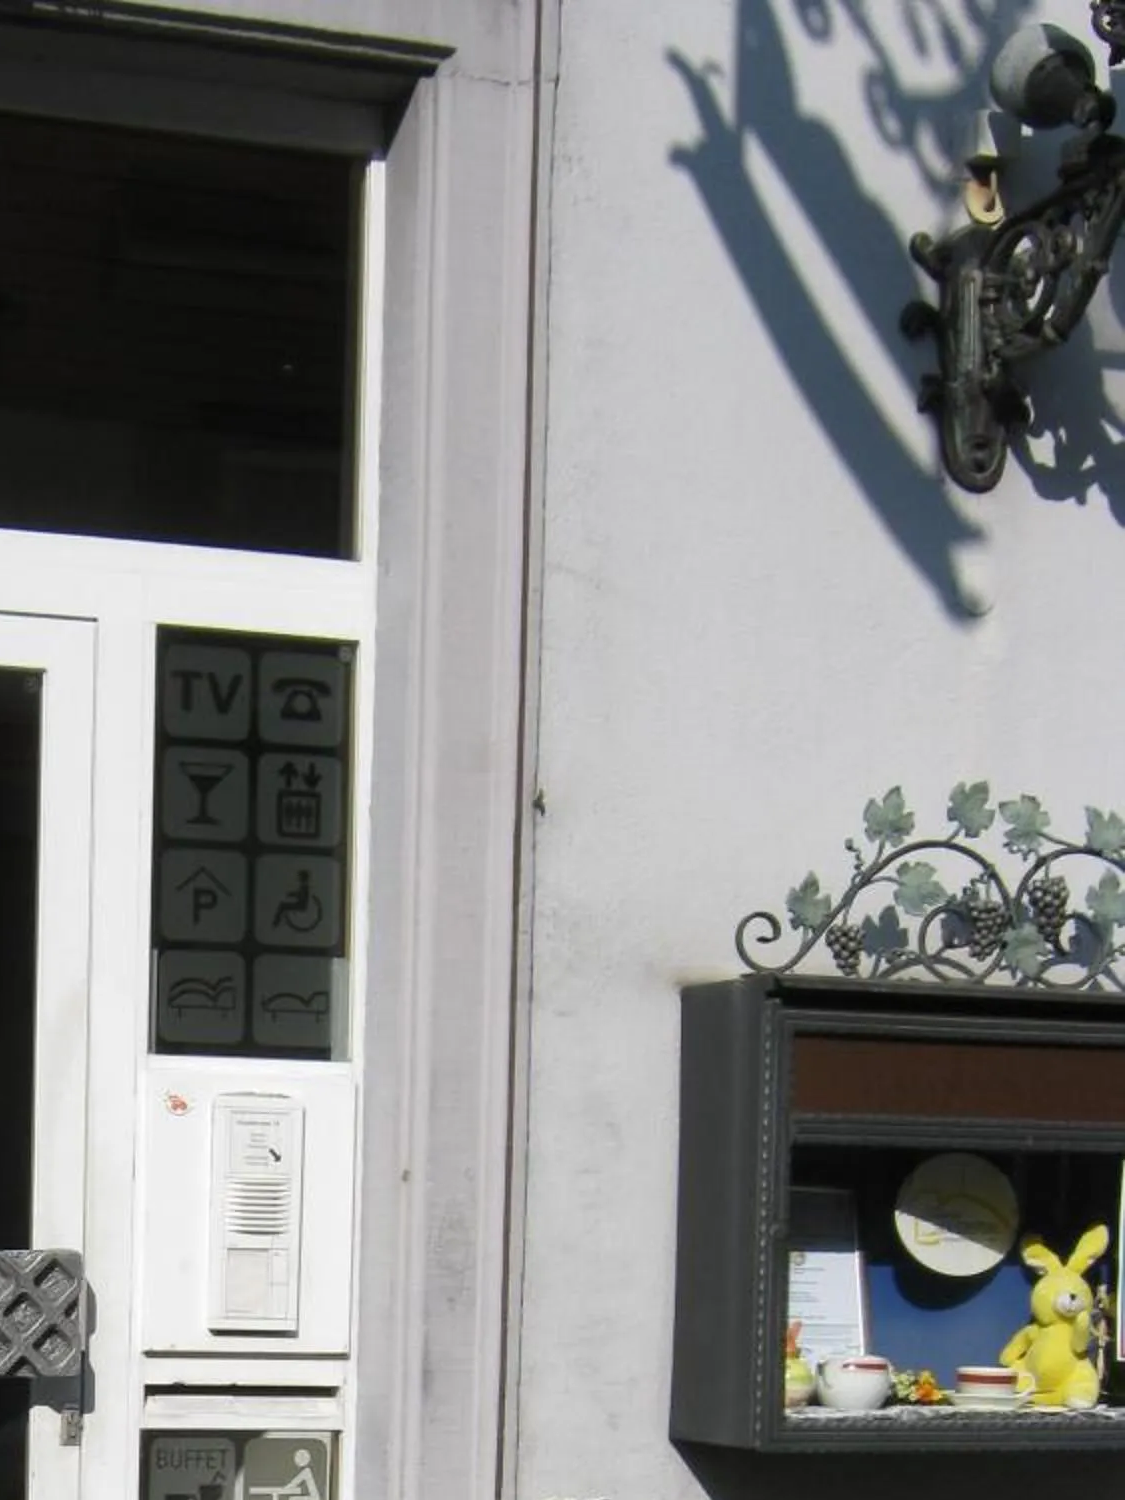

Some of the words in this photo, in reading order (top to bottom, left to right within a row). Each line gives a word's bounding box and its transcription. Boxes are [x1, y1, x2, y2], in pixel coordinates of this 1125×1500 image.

[170, 670, 243, 714] TV
[193, 889, 218, 924] P
[155, 1447, 228, 1471] BUFFET
